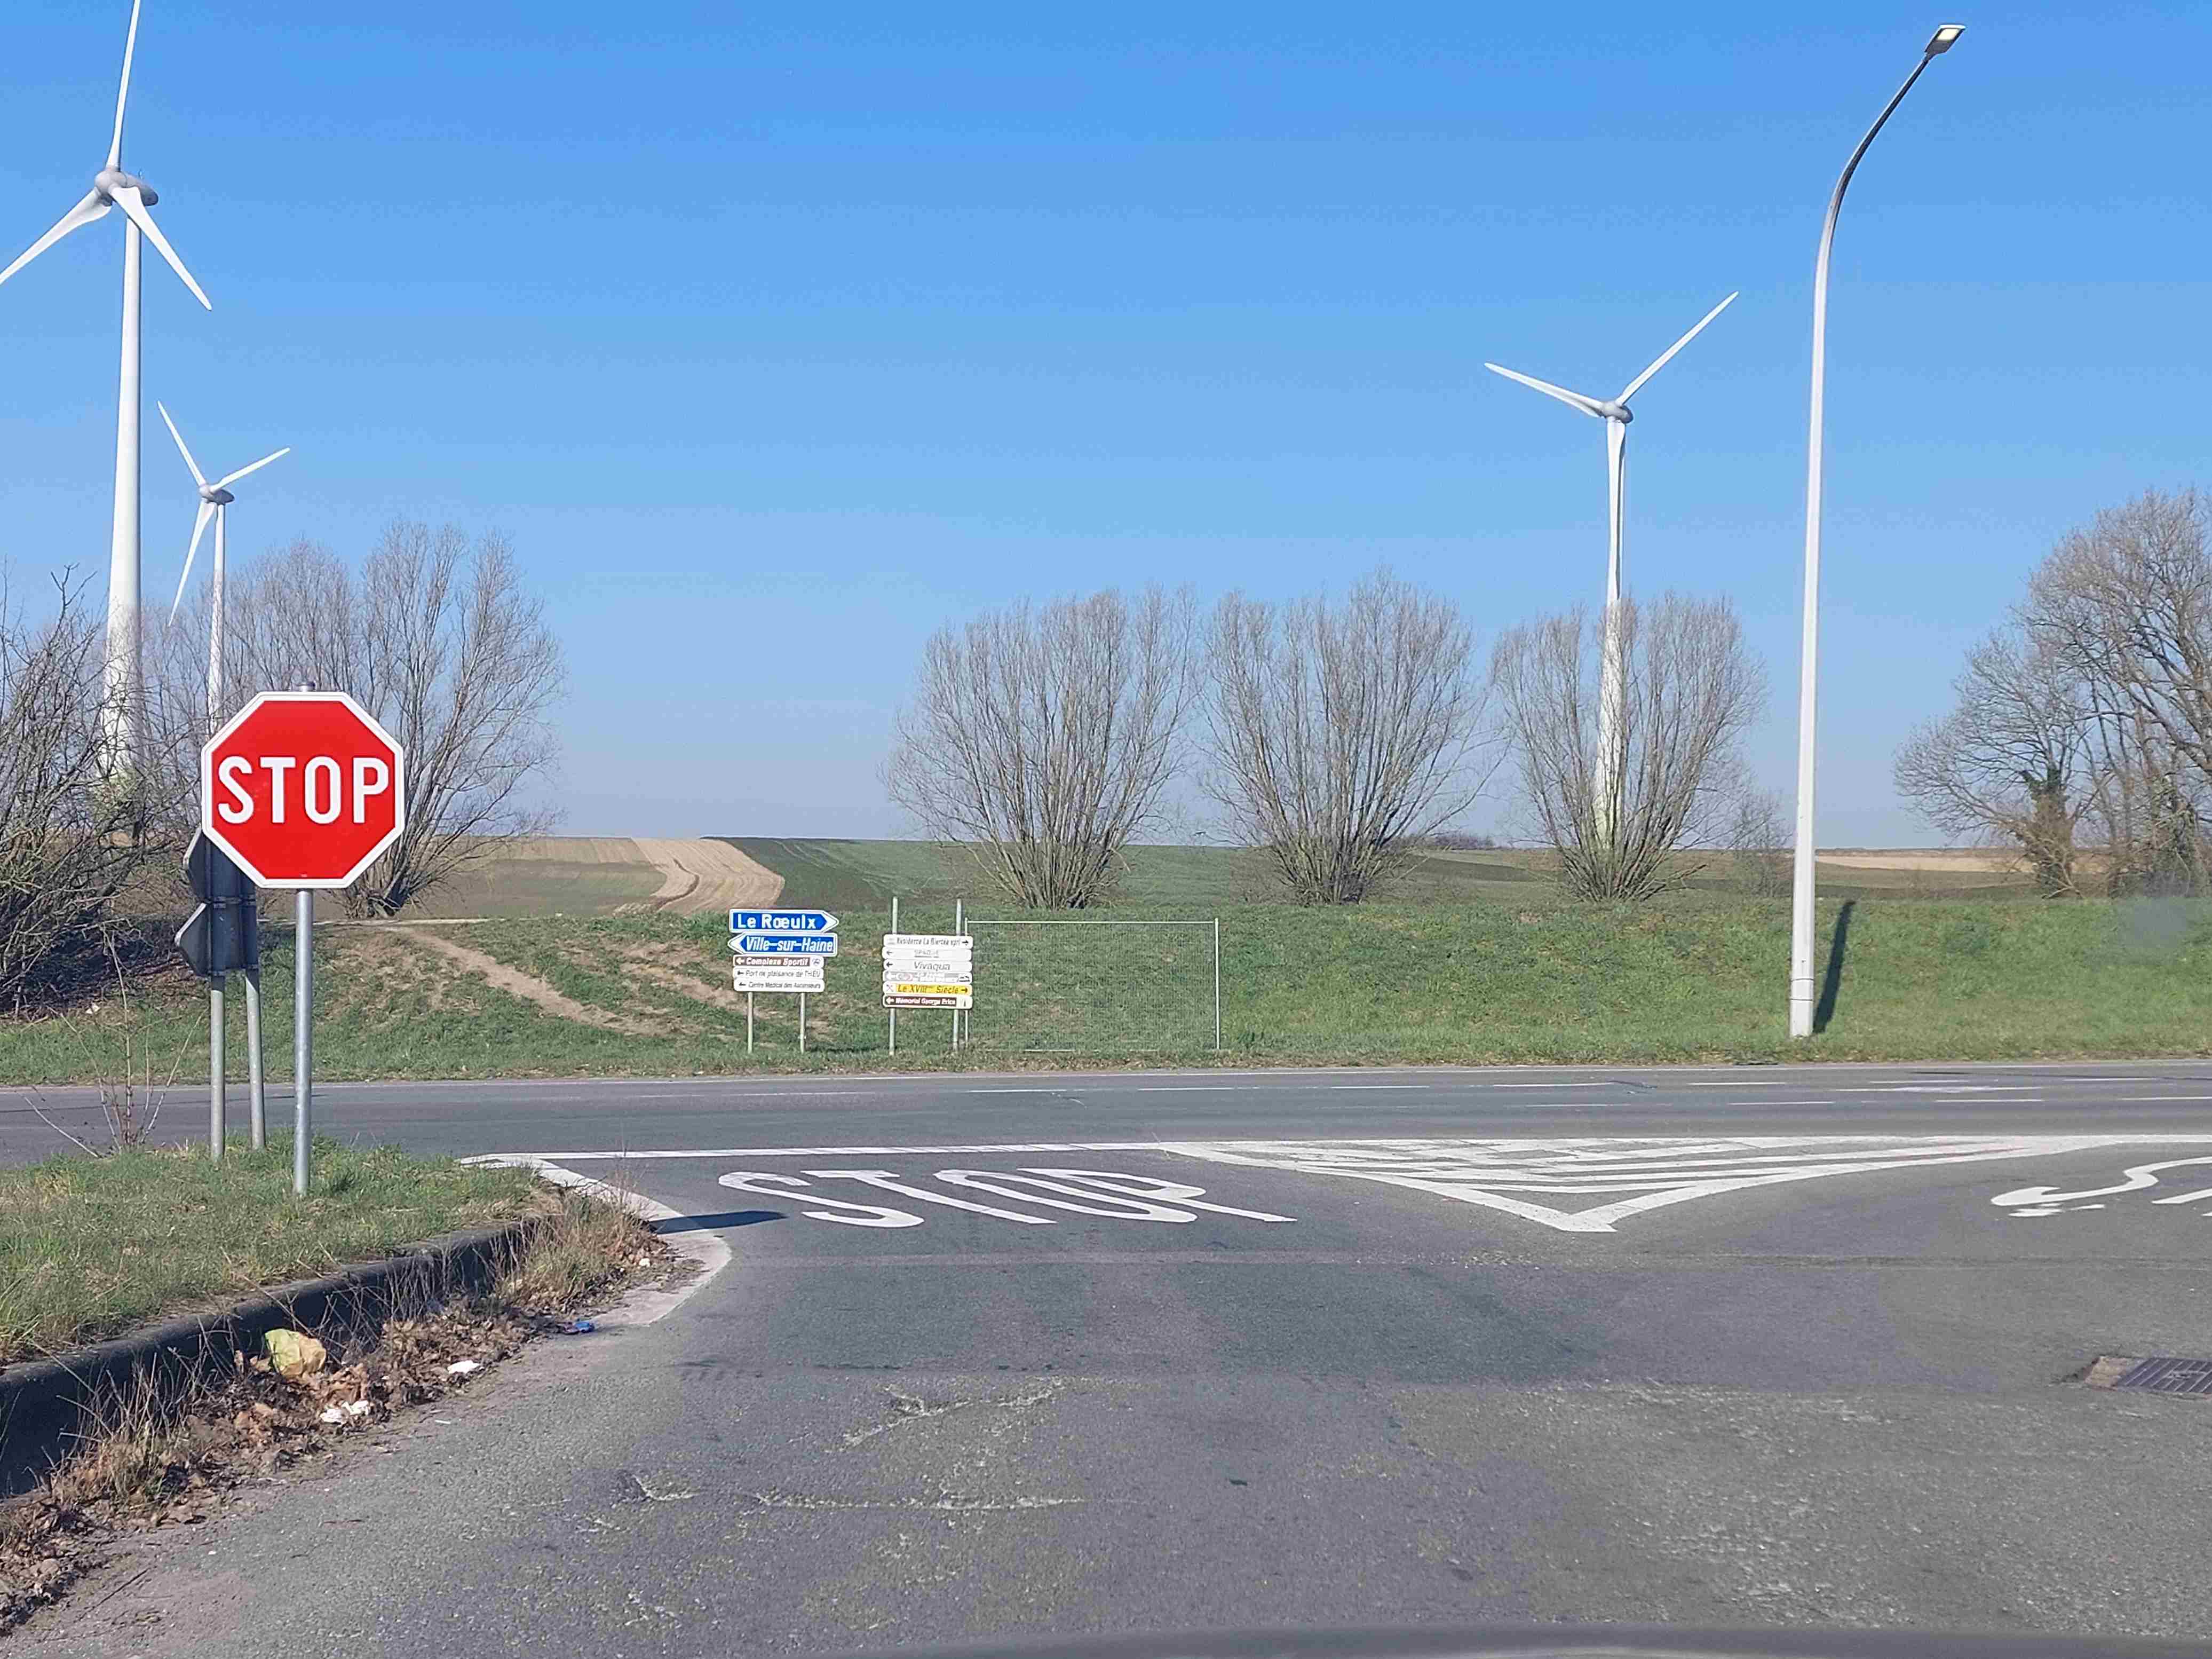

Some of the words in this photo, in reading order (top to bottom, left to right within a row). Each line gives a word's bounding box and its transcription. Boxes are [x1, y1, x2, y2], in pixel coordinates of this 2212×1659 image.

[218, 756, 389, 824] STOP
[737, 914, 756, 928] Le
[762, 914, 816, 929] Rœulx
[746, 936, 834, 952] Ville-sur-Haine
[746, 958, 781, 966] Complexe
[914, 961, 950, 971] Vivaqua
[718, 1168, 1298, 1227] STOP
